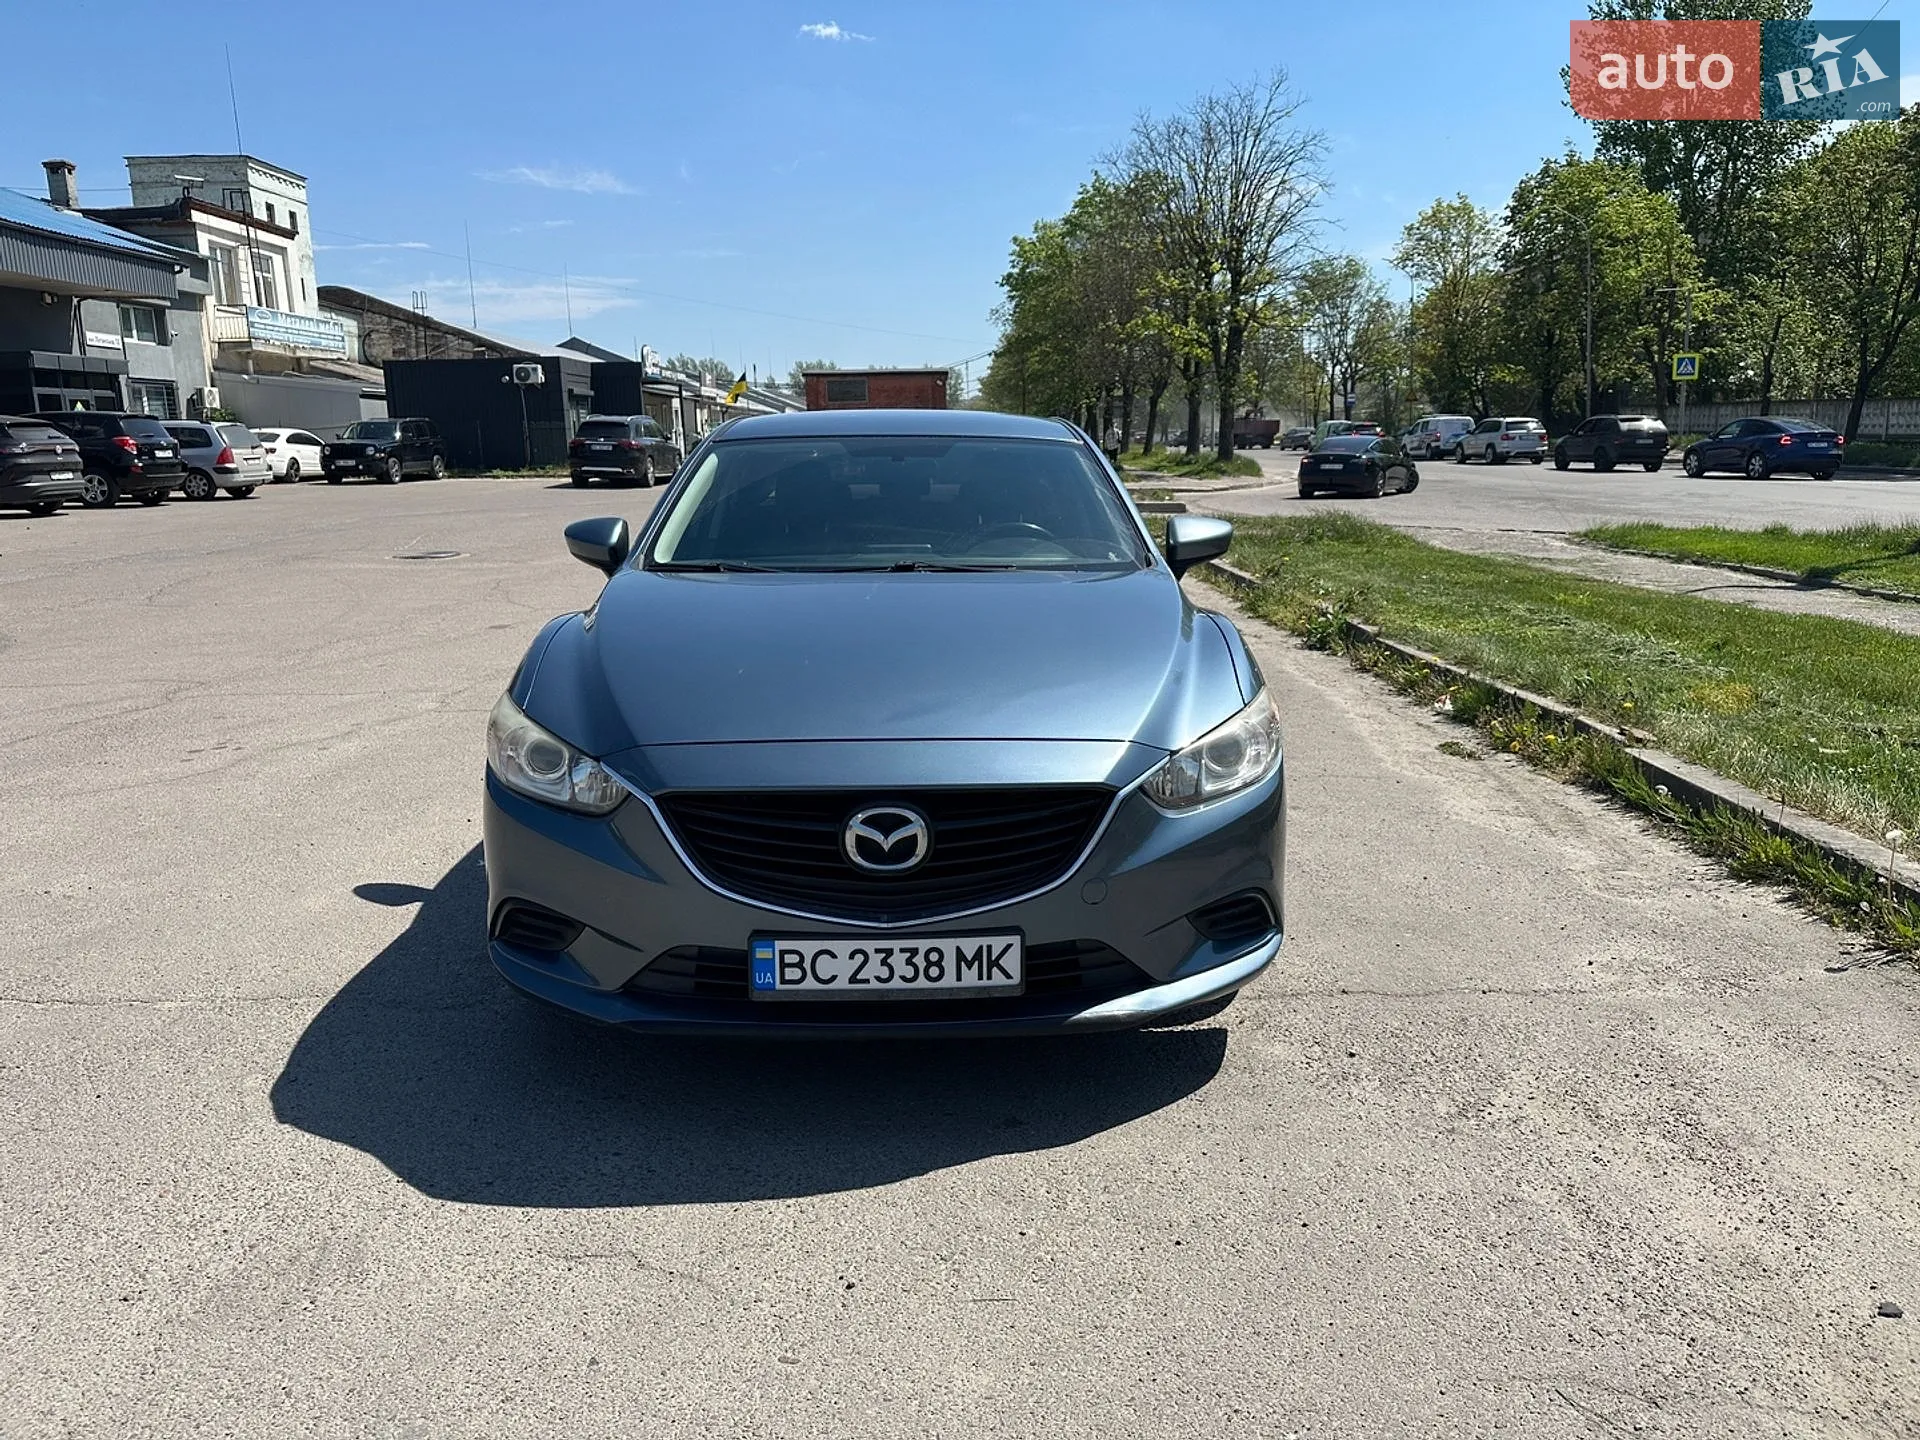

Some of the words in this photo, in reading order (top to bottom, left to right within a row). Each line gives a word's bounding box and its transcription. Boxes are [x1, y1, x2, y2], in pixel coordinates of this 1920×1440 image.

[778, 948, 838, 986] BC
[848, 947, 945, 985] 2338
[955, 943, 1014, 982] MK
[755, 973, 774, 985] UA
